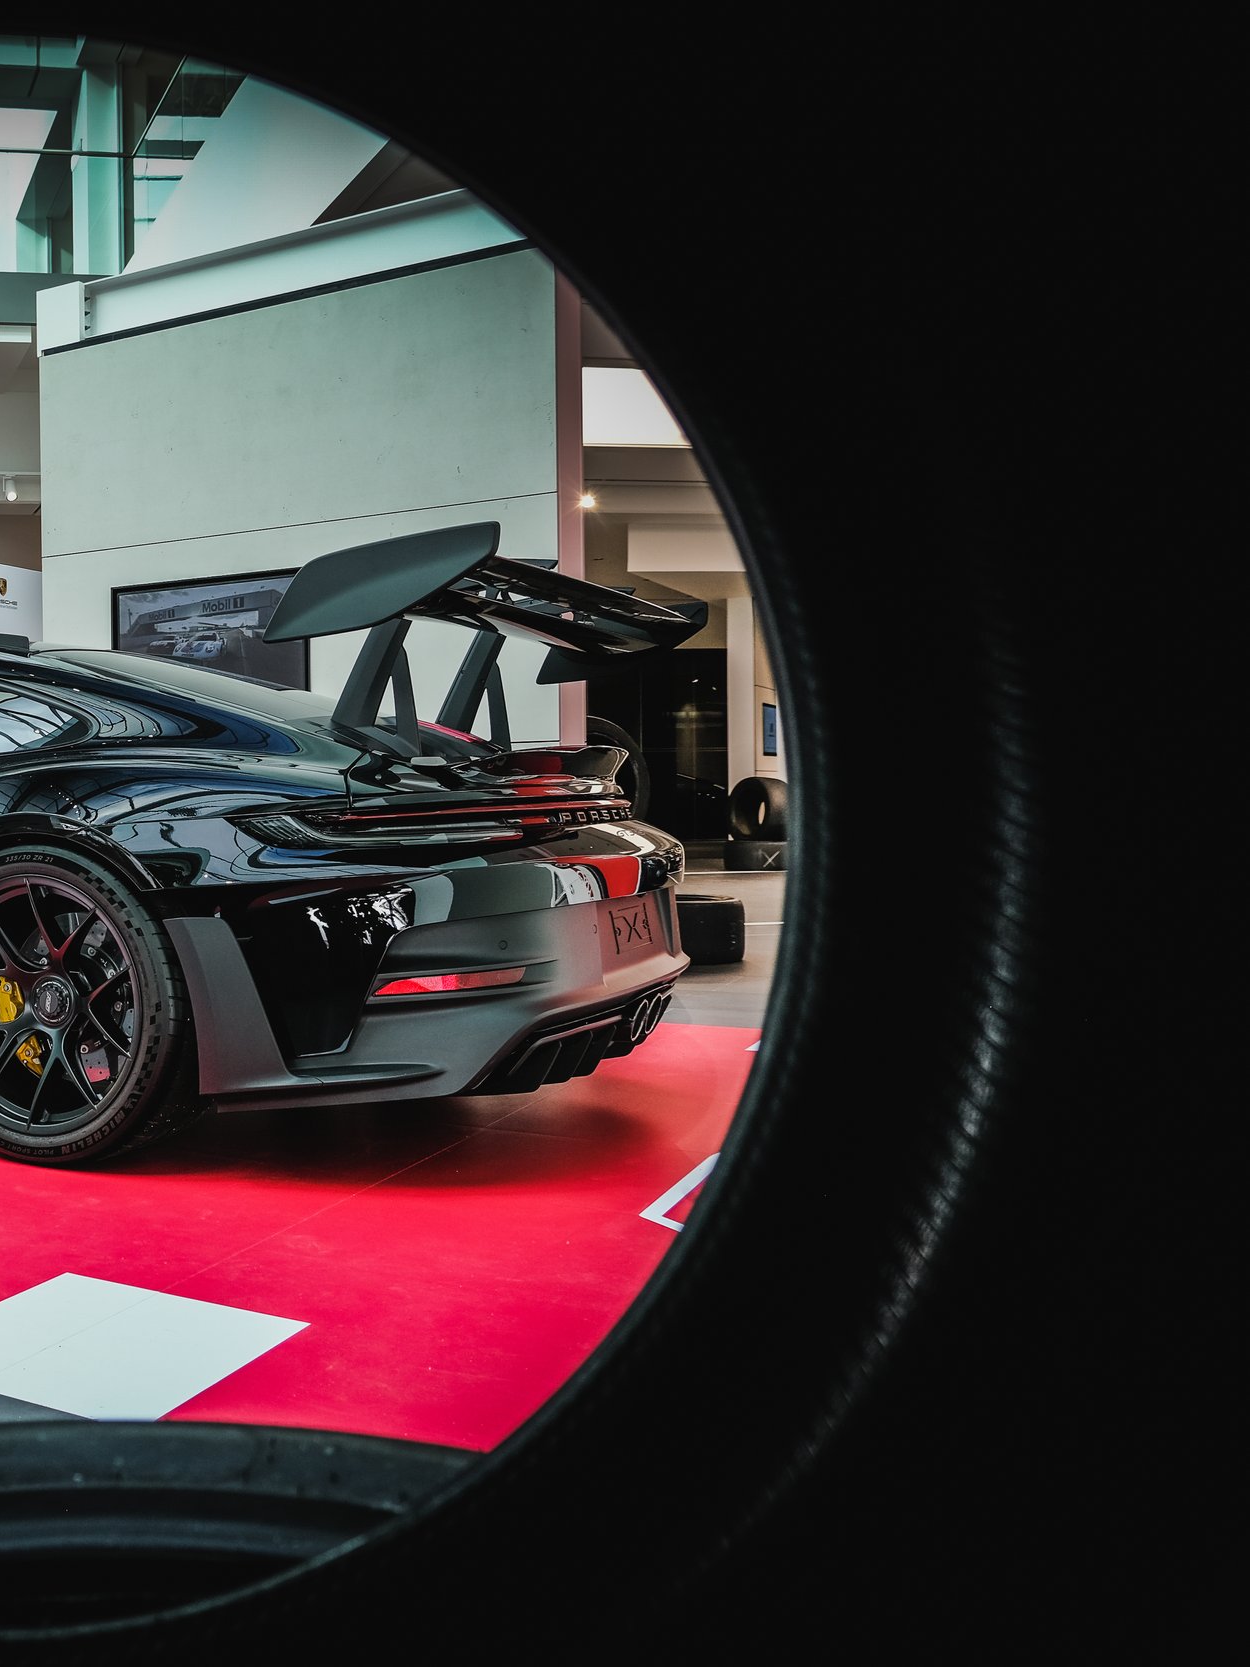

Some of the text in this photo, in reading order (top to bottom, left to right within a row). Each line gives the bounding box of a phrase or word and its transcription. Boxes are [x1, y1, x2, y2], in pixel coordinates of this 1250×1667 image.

[202, 598, 231, 613] Mobil
[148, 611, 167, 622] Mobil
[561, 808, 633, 823] PORSCHE
[32, 854, 43, 862] ZR
[61, 1110, 126, 1155] MICHELIN
